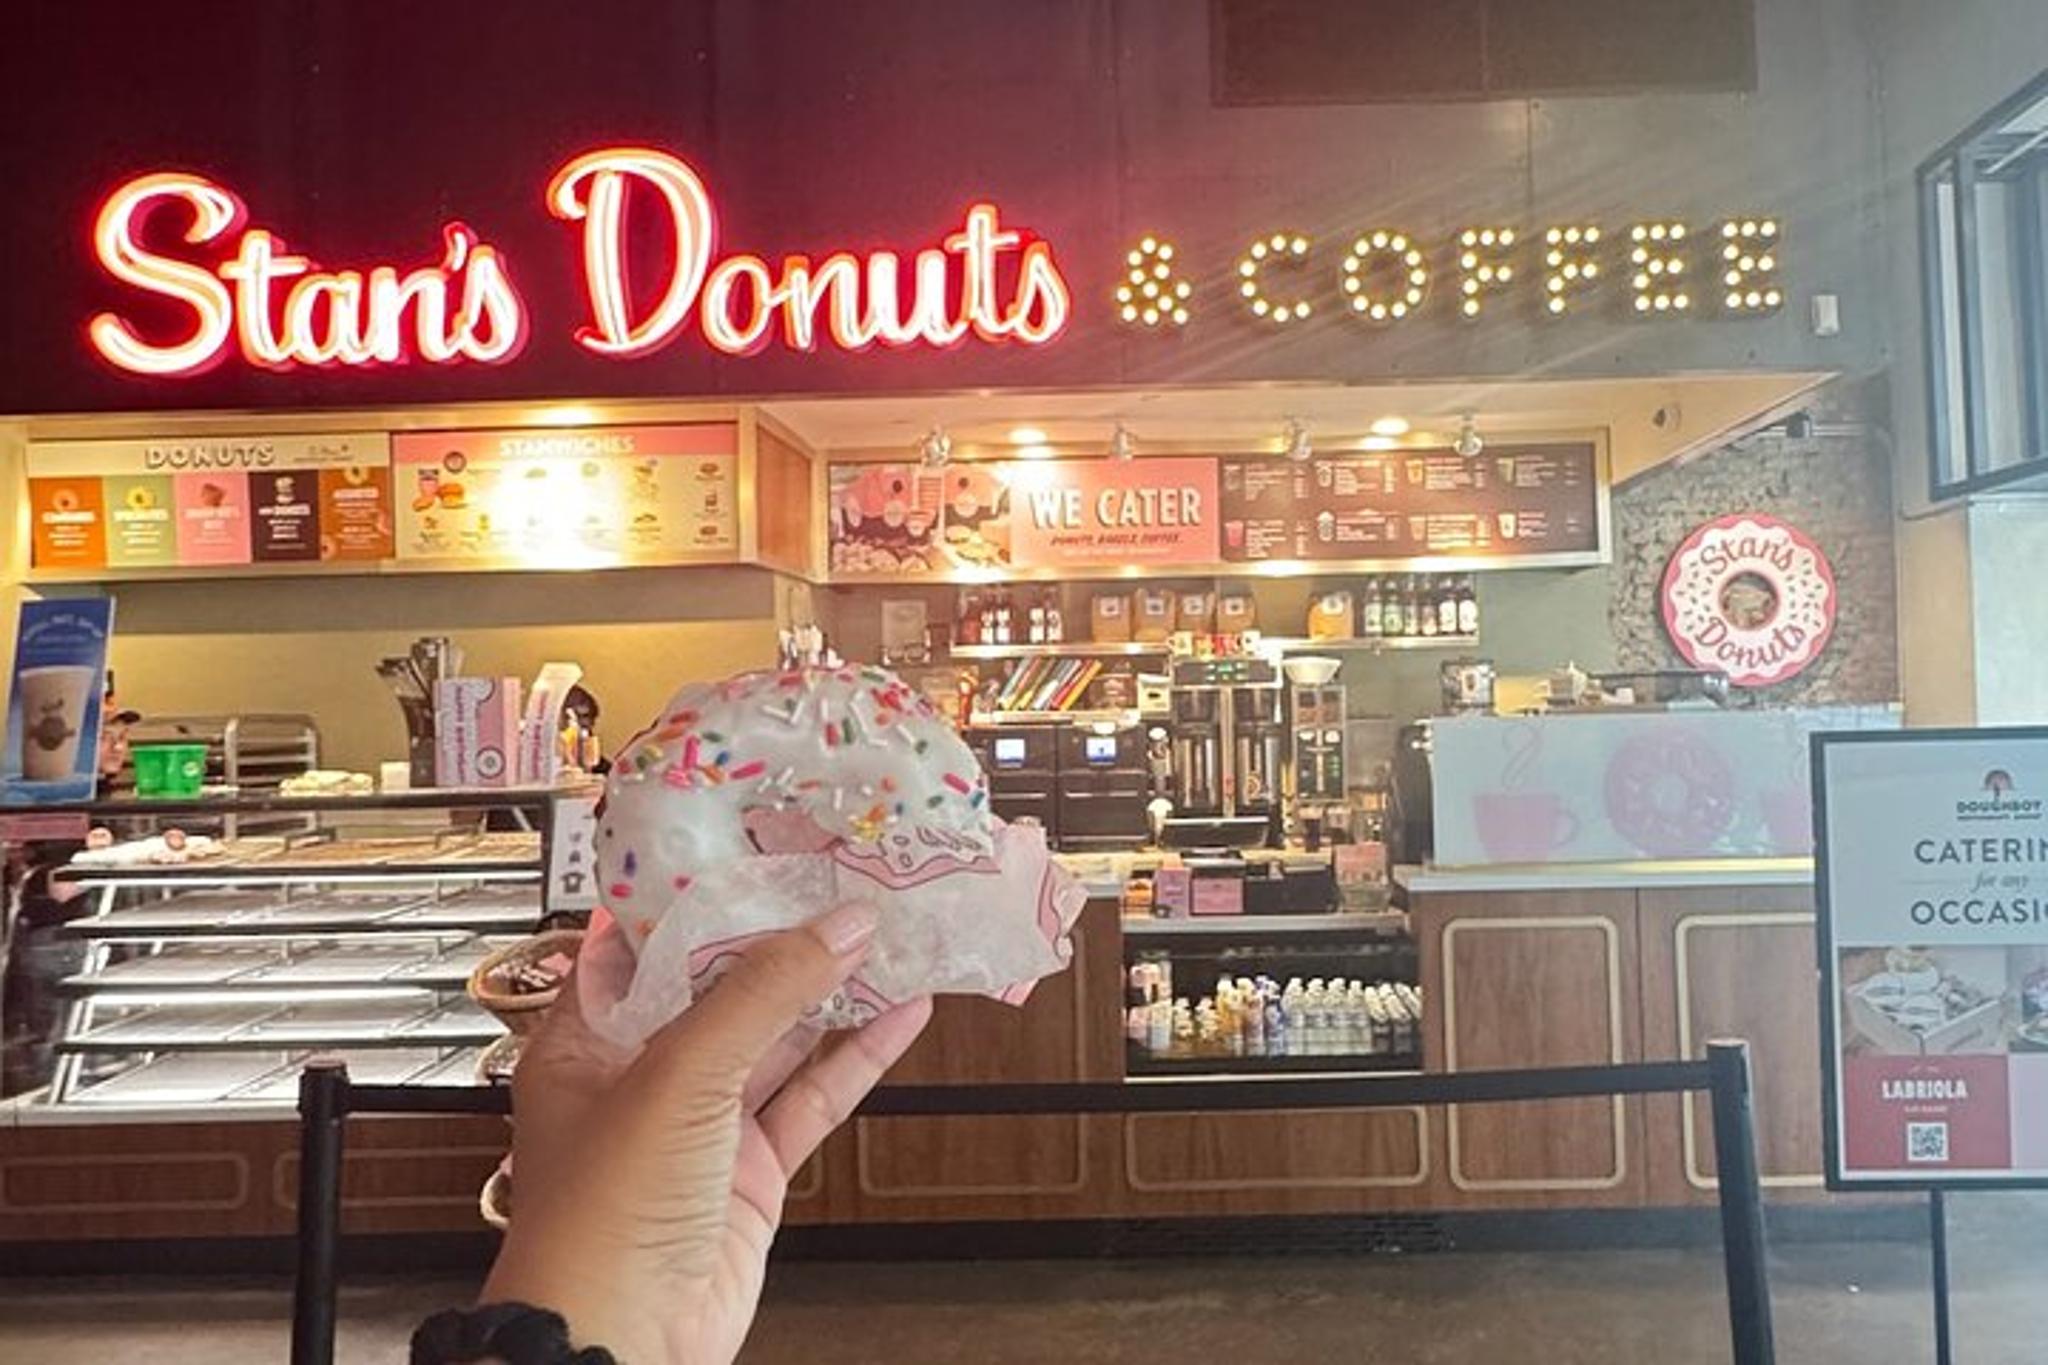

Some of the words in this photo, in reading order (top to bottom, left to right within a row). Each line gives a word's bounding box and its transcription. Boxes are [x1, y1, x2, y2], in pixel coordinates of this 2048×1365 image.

[90, 170, 526, 376] Stan's
[547, 146, 1072, 358] Donuts
[1116, 234, 1195, 326] &
[1237, 217, 1784, 322] COFFEE
[145, 445, 275, 469] DONUTS
[1029, 488, 1083, 529] WE
[1095, 486, 1201, 528] CATER
[1700, 536, 1796, 576] Stan's
[1694, 616, 1807, 669] Donuts
[1971, 871, 1996, 893] for
[1910, 899, 2048, 925] OCCASI
[1882, 1079, 1967, 1099] LABRIOLA
